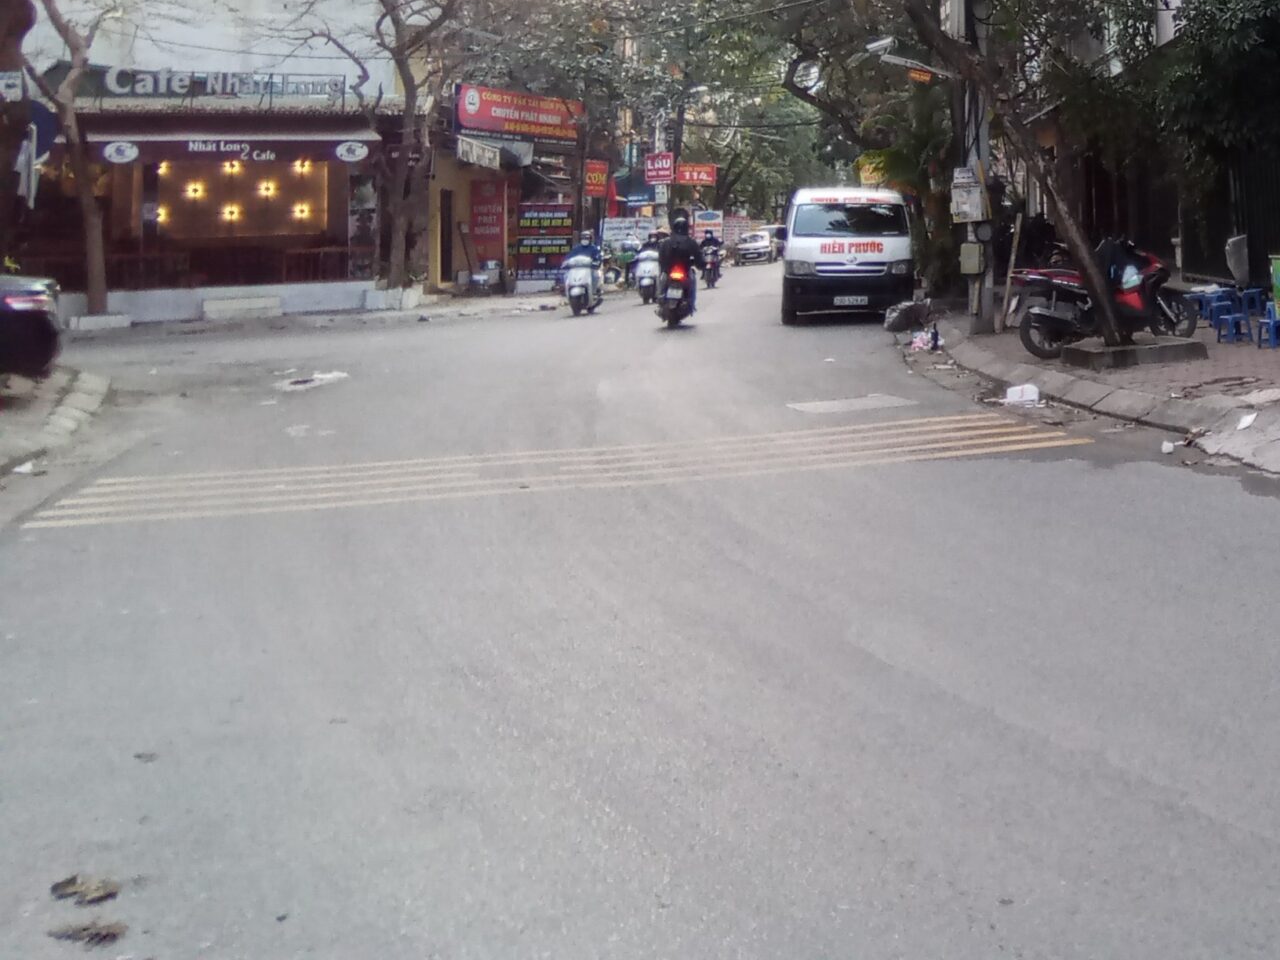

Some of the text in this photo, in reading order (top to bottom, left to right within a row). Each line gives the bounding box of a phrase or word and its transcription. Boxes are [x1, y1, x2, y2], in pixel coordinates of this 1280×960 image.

[105, 66, 190, 95] Cafe
[220, 141, 250, 160] Long
[252, 149, 276, 161] Cafe
